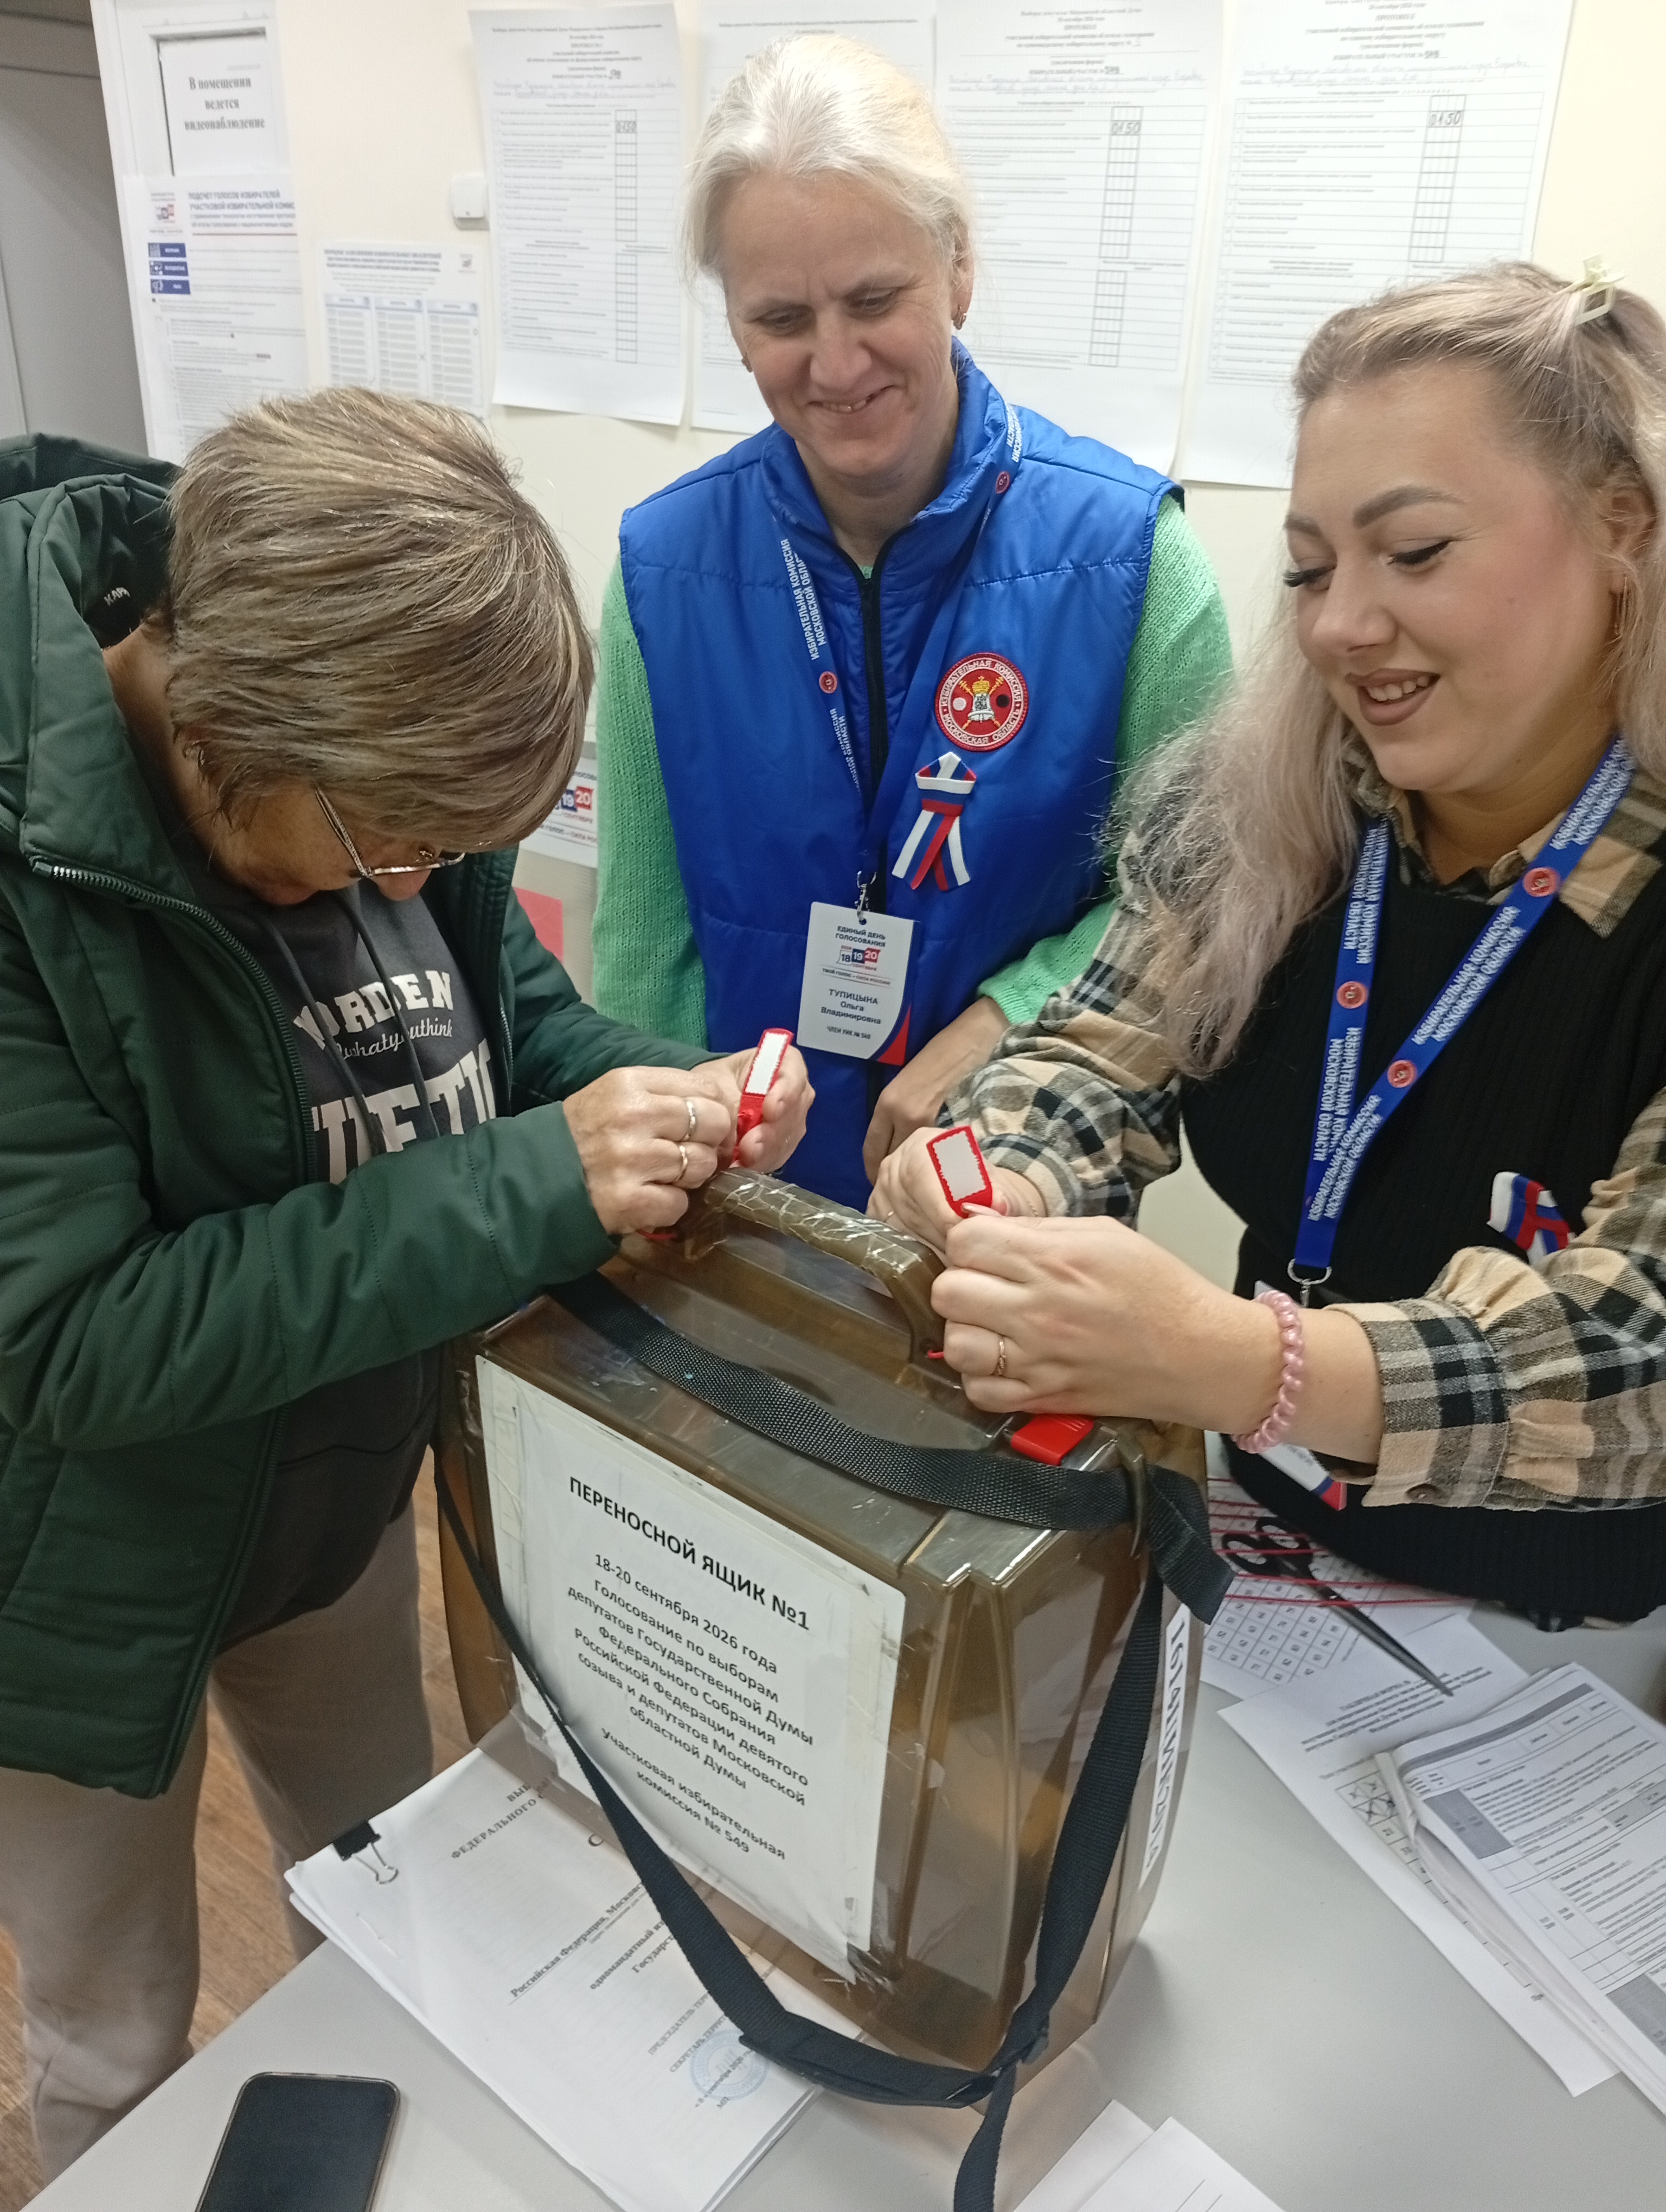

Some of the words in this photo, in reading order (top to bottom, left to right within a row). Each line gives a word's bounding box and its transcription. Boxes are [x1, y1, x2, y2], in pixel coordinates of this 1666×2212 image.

[780, 538, 800, 588] КОМИССИЯ
[792, 588, 820, 661] ИЗБИРАТЕЛЬНАЯ
[801, 586, 827, 646] МОСКОВСКОЙ
[941, 660, 992, 705] ИЗБИРАТЕЛЬНАЯ
[994, 663, 1022, 703] КОМИССИЯ
[942, 713, 989, 745] МОСКОВСКАЯ
[992, 710, 1021, 741] ОБЛАСТЬ
[563, 793, 574, 808] 19
[575, 790, 591, 806] 20
[835, 933, 886, 948] ГОЛОСОВАНИЯ
[837, 925, 867, 936] ЕДИНЫЙ
[867, 931, 886, 940] ДЕНЬ
[841, 953, 851, 962] 18
[853, 952, 863, 961] 19
[864, 950, 877, 960] 20
[1343, 901, 1362, 949] ОБЛАСТИ
[1356, 903, 1380, 964] КОМИССИЯ
[829, 988, 878, 1005] ТУПИЦЫНА
[840, 1001, 864, 1012] Ольга
[1411, 963, 1480, 1045] ИЗБИРАТЕЛЬНАЯ
[1468, 905, 1522, 965] КОМИССИЯ
[1431, 973, 1492, 1042] МОСКОВСКОЙ
[1479, 925, 1527, 975] ОБЛАСТИ
[821, 1006, 882, 1025] Владимировна
[827, 1026, 842, 1034] ЧЛЕН
[842, 1028, 853, 1037] УИК
[1319, 1038, 1345, 1111] МОСКОВСКОЙ
[1334, 1027, 1362, 1116] ИЗБИРАТЕЛЬНАЯ
[1307, 1147, 1346, 1221] ИЗБИРАТЕЛЬНАЯ
[1338, 1094, 1383, 1147] КОМИССИЯ
[1312, 1113, 1334, 1162] ОБЛАСТИ
[1323, 1158, 1356, 1219] МОСКОВСКОЙ
[1347, 1113, 1383, 1159] ОБЛАСТИ
[570, 1476, 696, 1565] ПЕРЕНОСНОЙ
[702, 1555, 766, 1606] ЯЩИК
[772, 1594, 810, 1631] №1
[594, 1579, 683, 1644] Голосование
[687, 1639, 704, 1656] по
[708, 1652, 779, 1703] выборам
[595, 1554, 631, 1585] 18-20
[635, 1580, 699, 1627] сентября
[703, 1619, 738, 1649] 2026
[742, 1645, 777, 1674] года
[568, 1587, 634, 1635] депутатов
[637, 1628, 762, 1715] Государственной
[766, 1709, 813, 1746] Думы
[598, 1626, 699, 1697] Федерального
[702, 1692, 777, 1745] Собрания
[574, 1627, 650, 1686] Российской
[653, 1681, 735, 1741] Федерации
[739, 1738, 809, 1786] девятого
[578, 1652, 623, 1689] созыва
[626, 1684, 636, 1696] и
[638, 1694, 709, 1745] депутатов
[713, 1738, 805, 1806] Московской
[630, 1706, 700, 1759] областной
[703, 1754, 747, 1790] Думы
[601, 1727, 675, 1785] Участковая
[678, 1782, 785, 1860] избирательная
[636, 1771, 701, 1821] комиссия
[704, 1816, 721, 1835] №
[725, 1829, 749, 1853] 549
[451, 1798, 537, 1859] ФЕДЕРАЛЬНОГО
[510, 1956, 561, 1997] Российская
[560, 1916, 609, 1956] Федерация,
[605, 1881, 643, 1915] Московс
[590, 1928, 655, 1990] одномандатный
[631, 1935, 674, 1974] Государст
